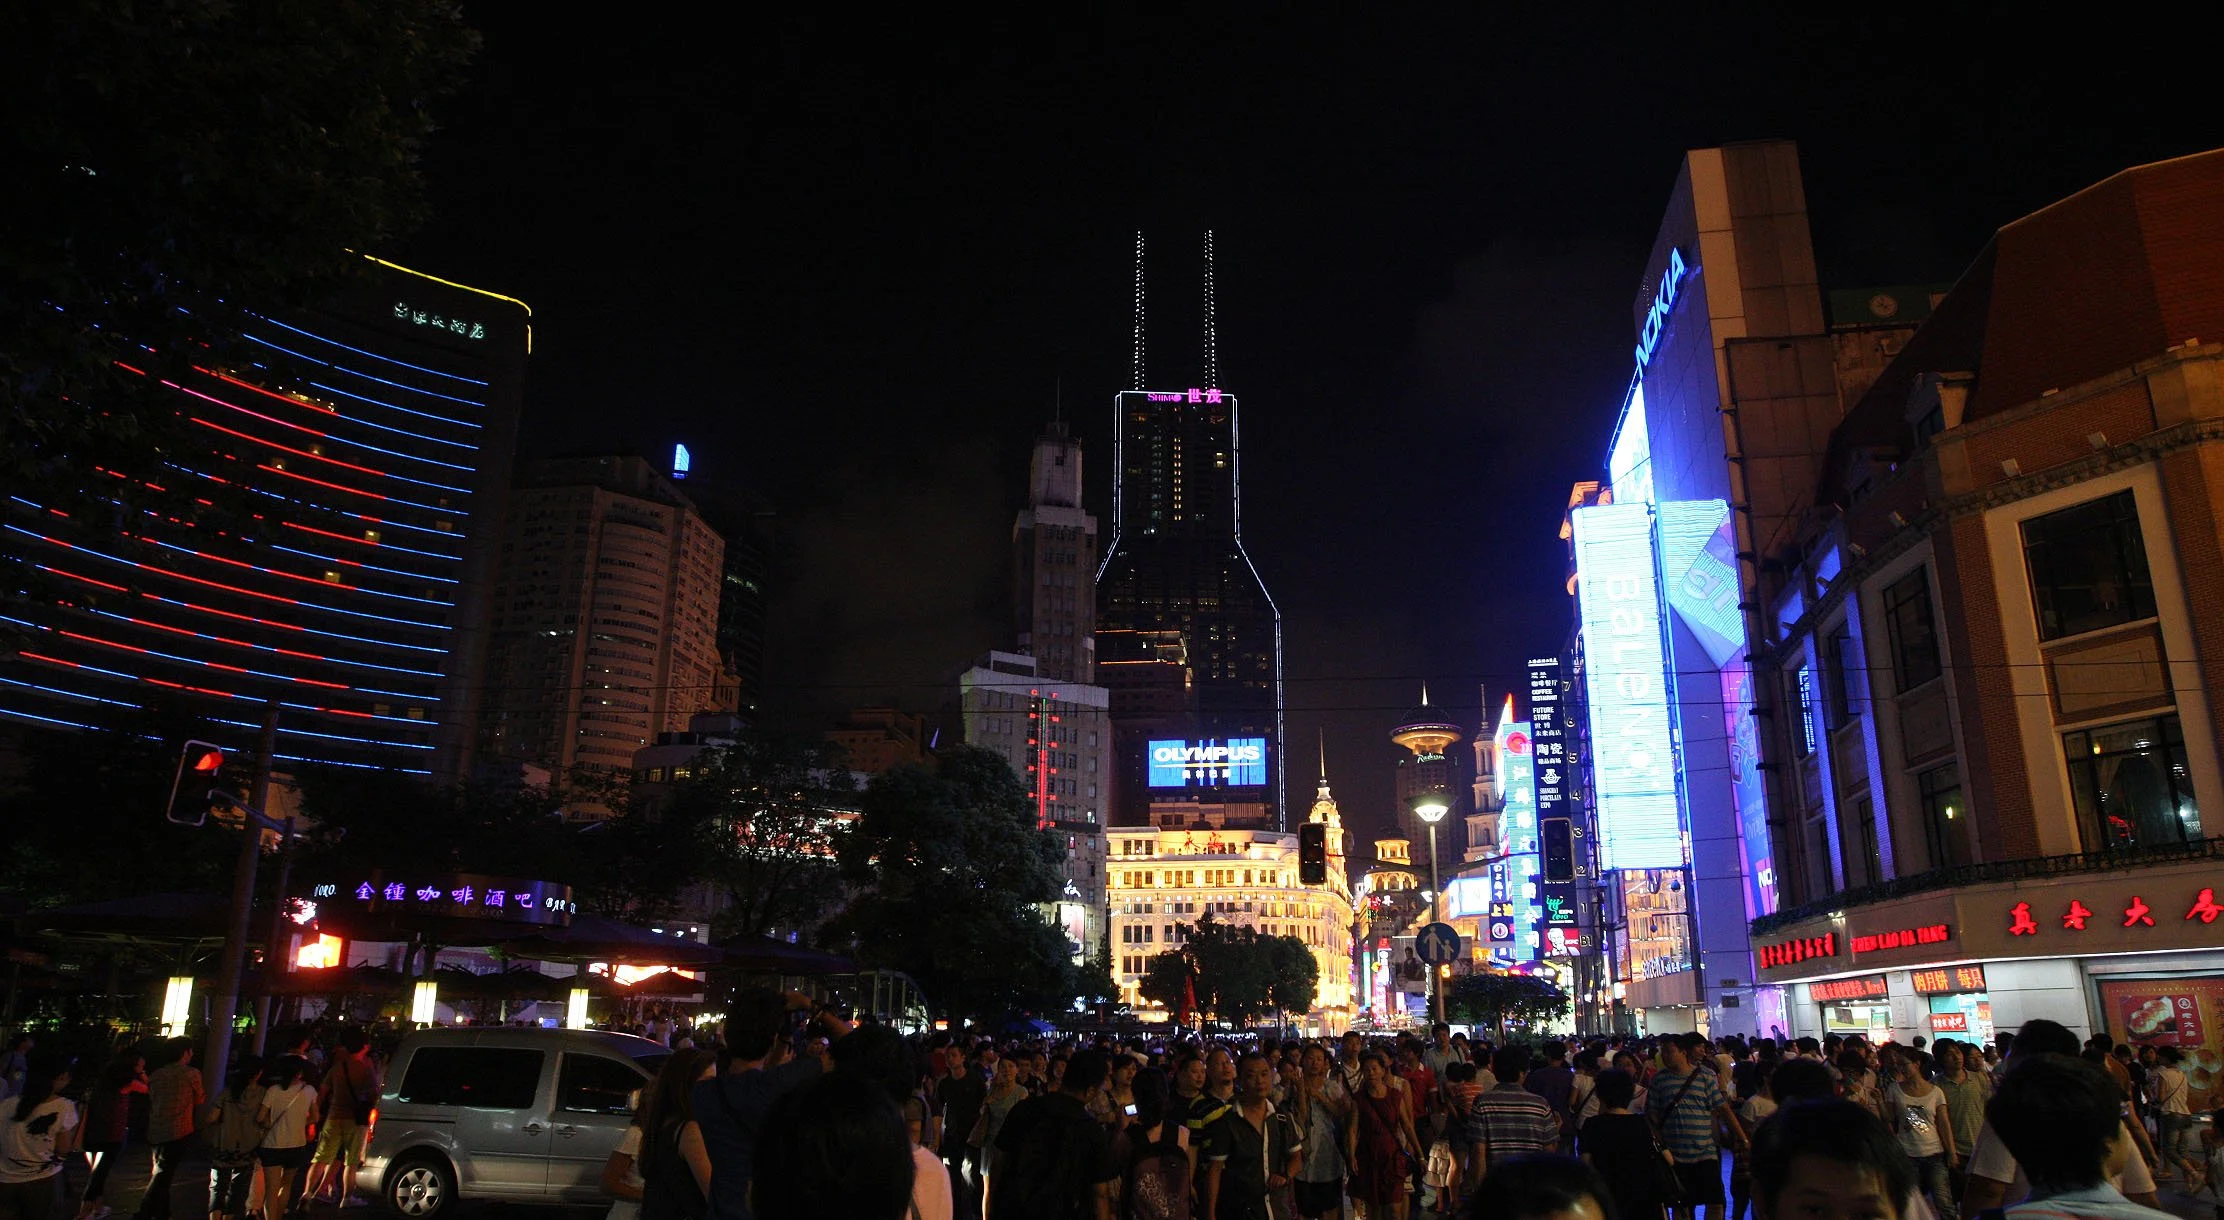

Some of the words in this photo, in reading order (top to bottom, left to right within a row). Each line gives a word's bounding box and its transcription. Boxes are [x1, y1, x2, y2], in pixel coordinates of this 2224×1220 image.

[1635, 248, 1685, 380] NOKIA
[1188, 388, 1222, 404] 世茂
[1563, 681, 1571, 692] 7
[1567, 718, 1575, 728] 6
[1154, 745, 1260, 762] OLYMPUS
[1536, 743, 1563, 755] 陶瓷
[1569, 752, 1578, 763] 5
[1572, 789, 1581, 801] 4
[1573, 827, 1583, 838] 3
[1576, 866, 1586, 877] 2
[545, 897, 566, 912] BAR
[1580, 935, 1593, 947] B1
[1878, 931, 1899, 949] LAO
[1917, 924, 1948, 944] FANG
[1957, 966, 1985, 988] 每只
